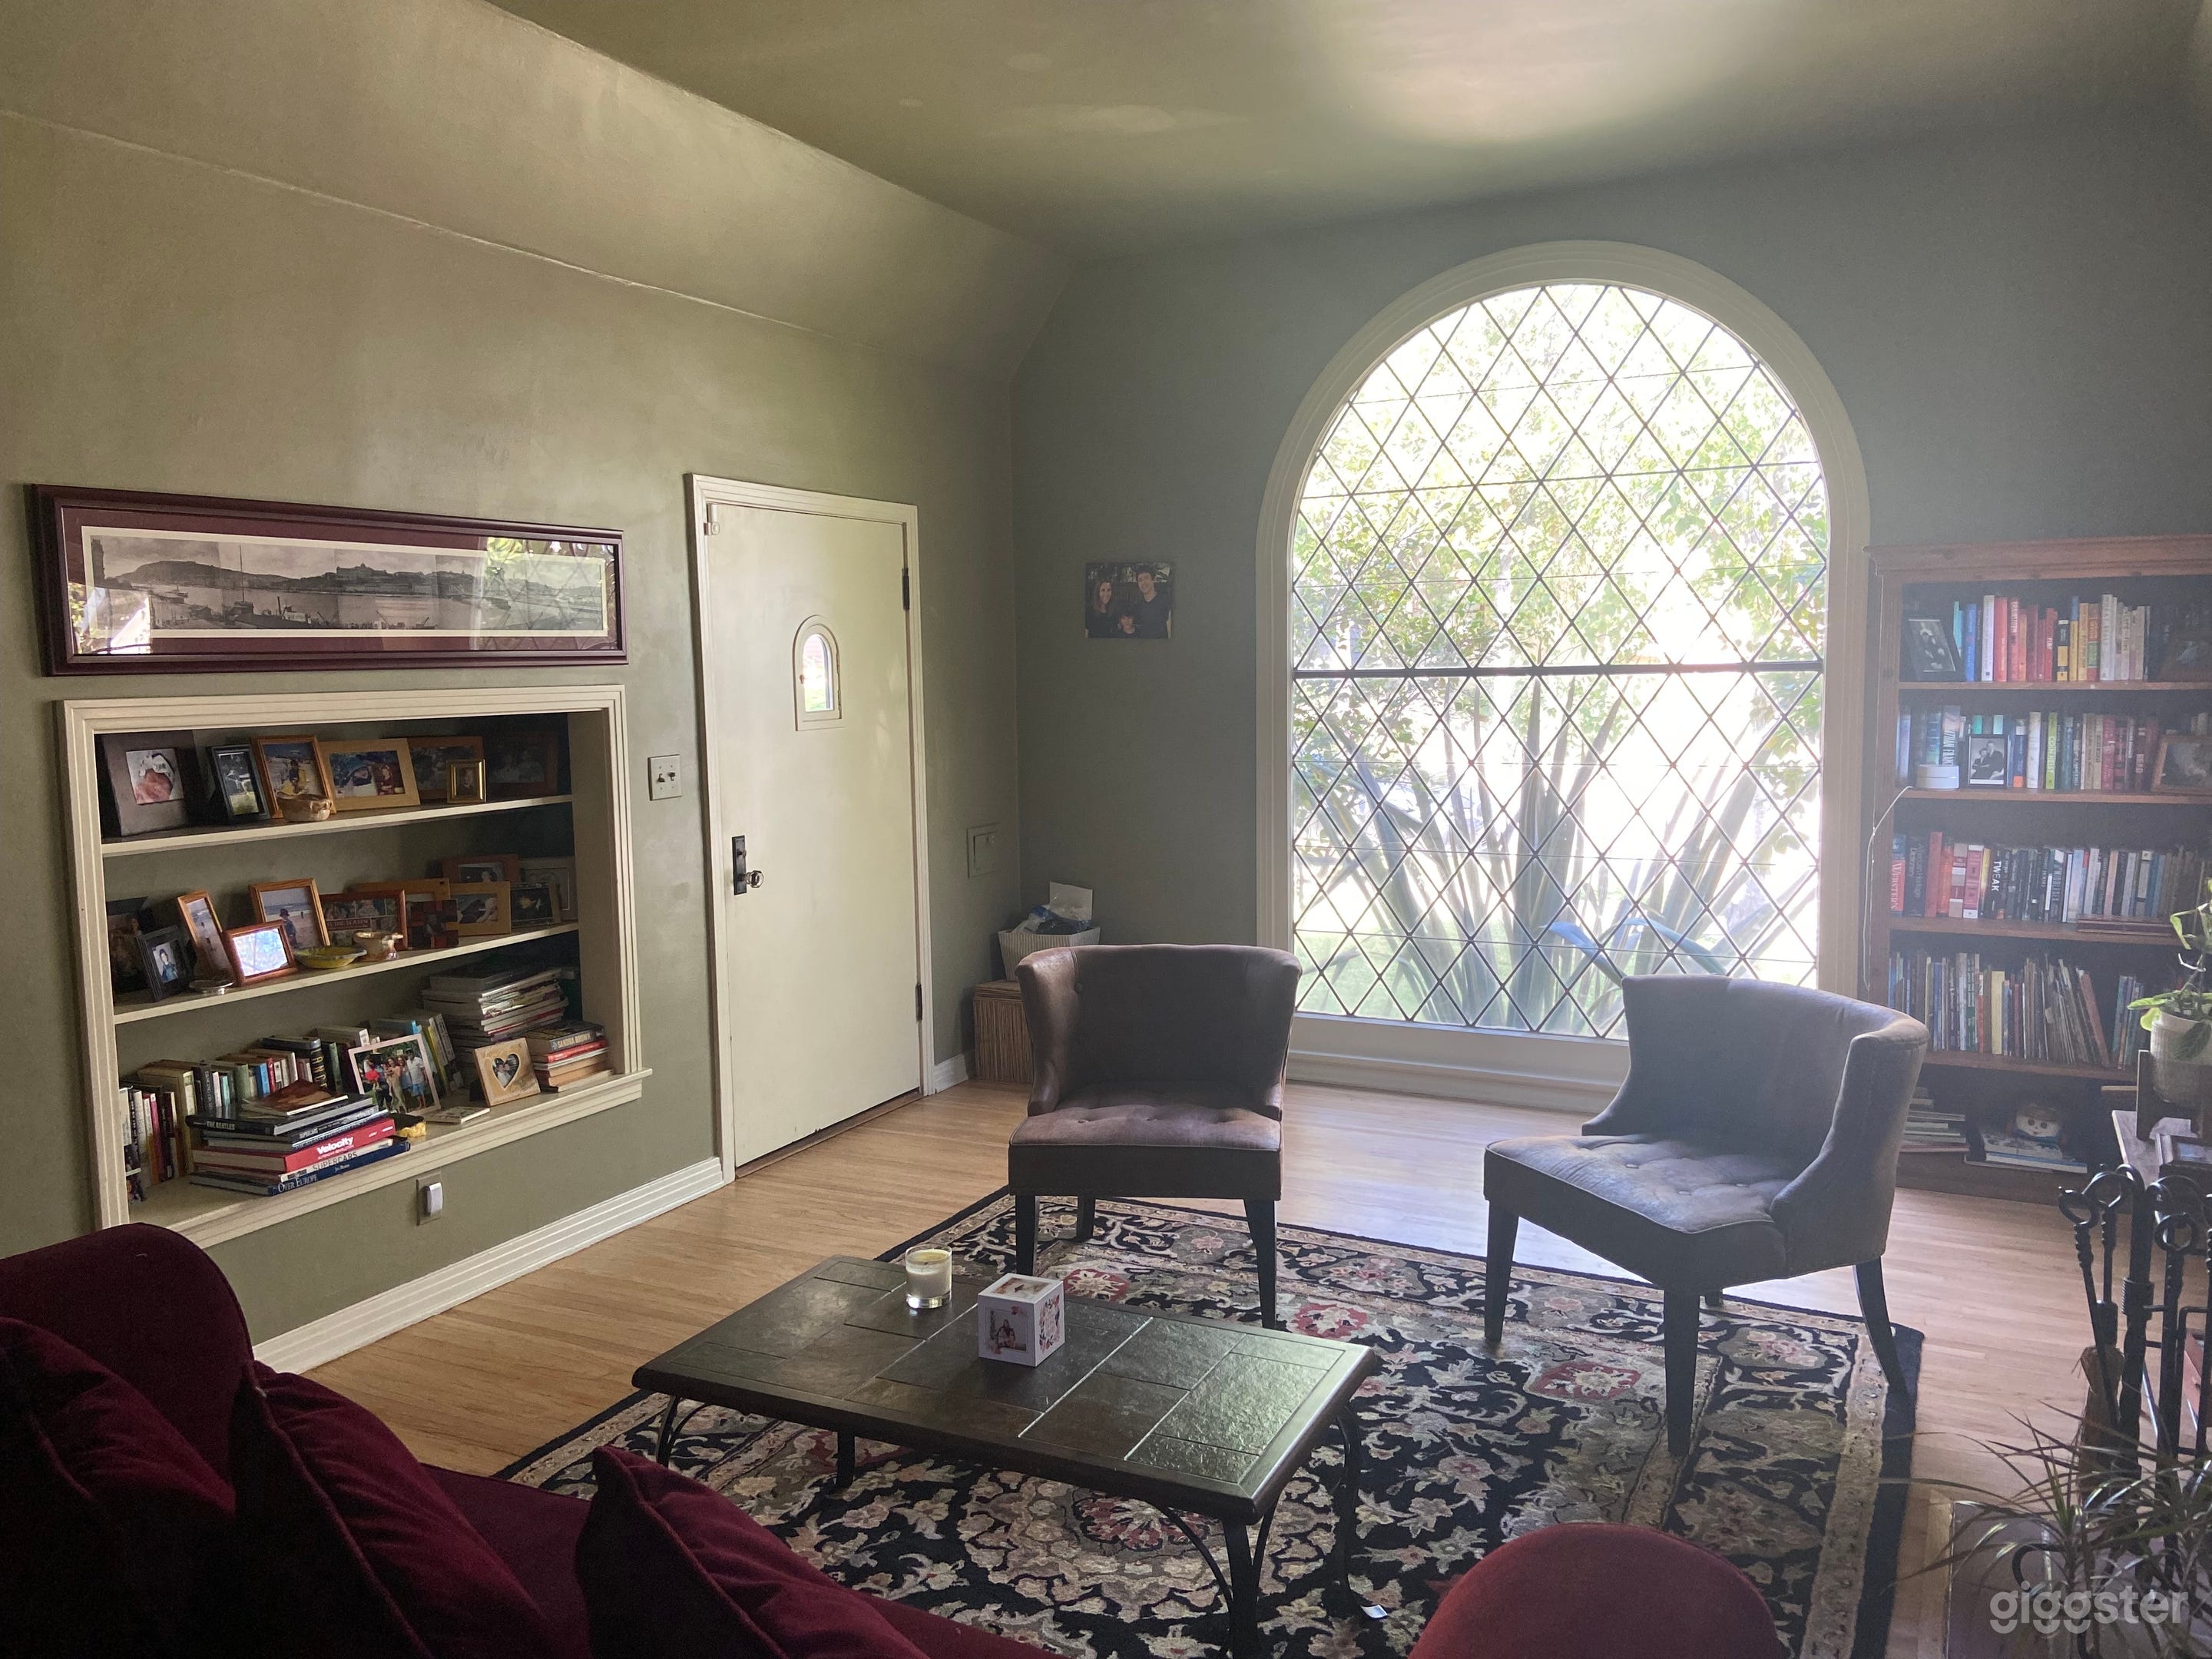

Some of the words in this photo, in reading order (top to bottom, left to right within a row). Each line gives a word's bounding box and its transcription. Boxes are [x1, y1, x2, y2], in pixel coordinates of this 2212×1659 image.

[1942, 749, 1954, 766] FRAN
[2135, 753, 2144, 774] READ
[1991, 861, 2002, 892] TWEAK
[1891, 863, 1902, 910] WEBSTER'S
[557, 1037, 575, 1048] SANDRA
[215, 1122, 235, 1131] BEATLES
[316, 1137, 354, 1154] Velocity
[313, 1151, 358, 1171] SUPERCARS
[278, 1182, 295, 1193] OVER
[296, 1174, 318, 1187] EUROPE
